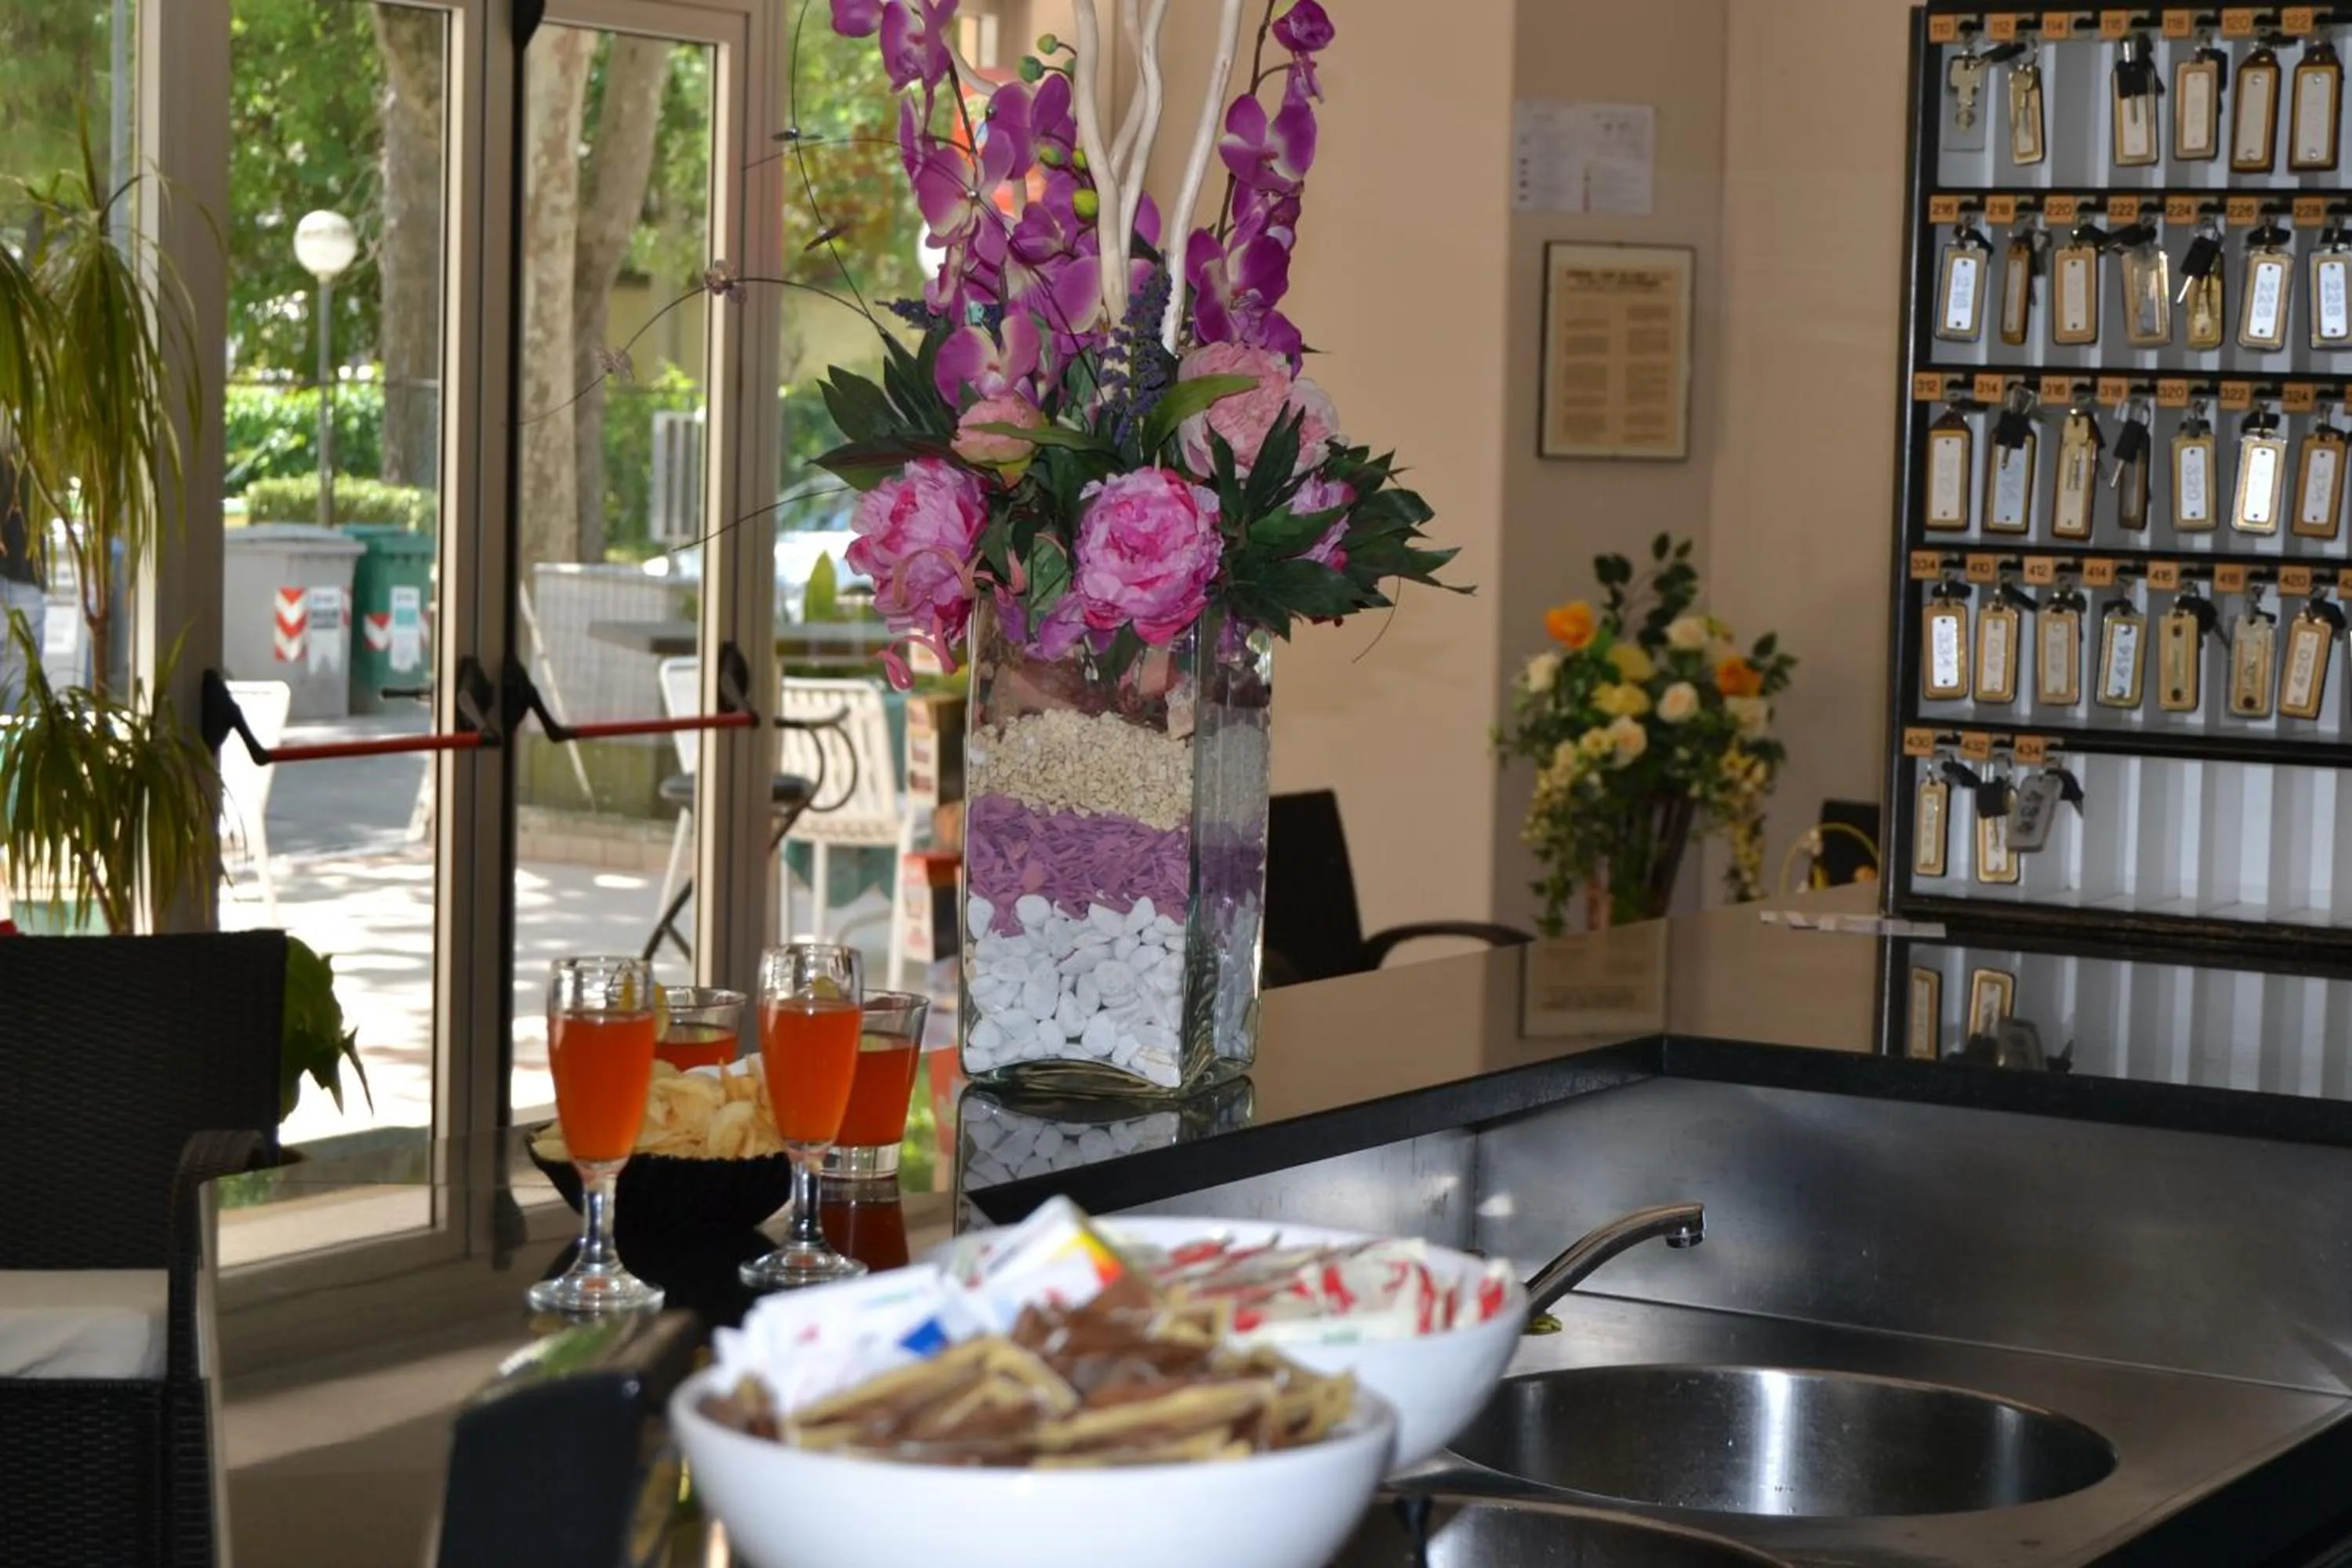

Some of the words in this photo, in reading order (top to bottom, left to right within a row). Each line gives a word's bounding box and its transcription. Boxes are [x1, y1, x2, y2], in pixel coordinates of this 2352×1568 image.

[2046, 201, 2071, 216] 220
[2110, 202, 2135, 216] 222
[2168, 202, 2191, 216] 224
[2229, 204, 2252, 217] 226
[1917, 378, 1937, 391] 312
[1977, 379, 1998, 393] 314
[2159, 385, 2184, 399] 320
[2221, 387, 2246, 401] 322
[2028, 563, 2049, 577] 412
[2281, 574, 2308, 587] 420
